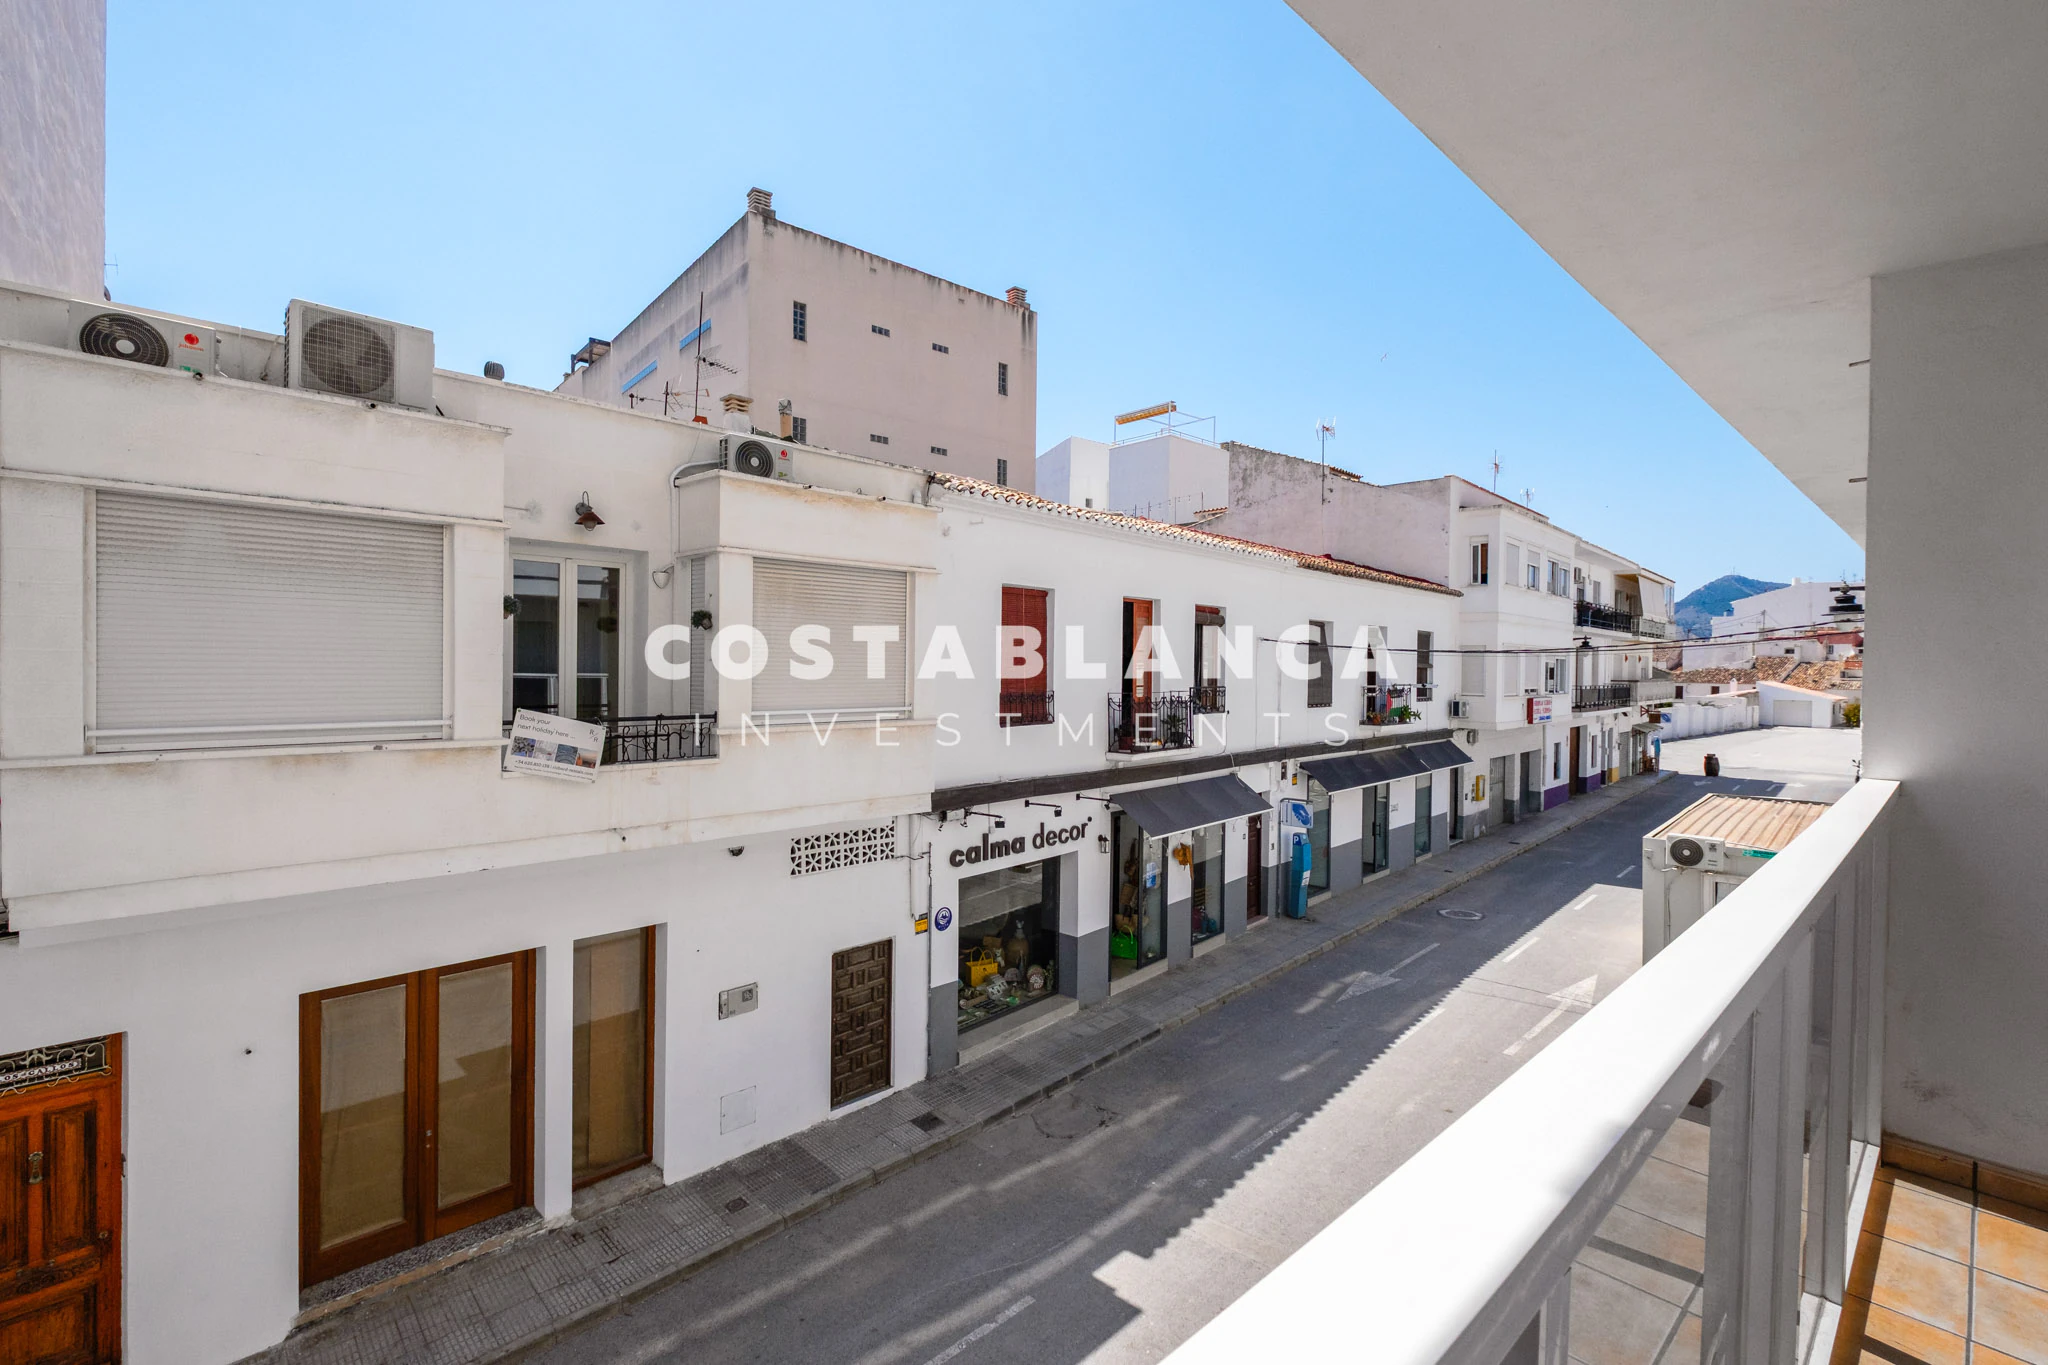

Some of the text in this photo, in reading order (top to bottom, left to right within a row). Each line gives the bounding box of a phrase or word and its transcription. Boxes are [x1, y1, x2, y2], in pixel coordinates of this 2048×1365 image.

[519, 714, 535, 722] Book
[533, 726, 554, 736] holiday
[556, 730, 569, 738] here
[950, 822, 1088, 867] calma decor
